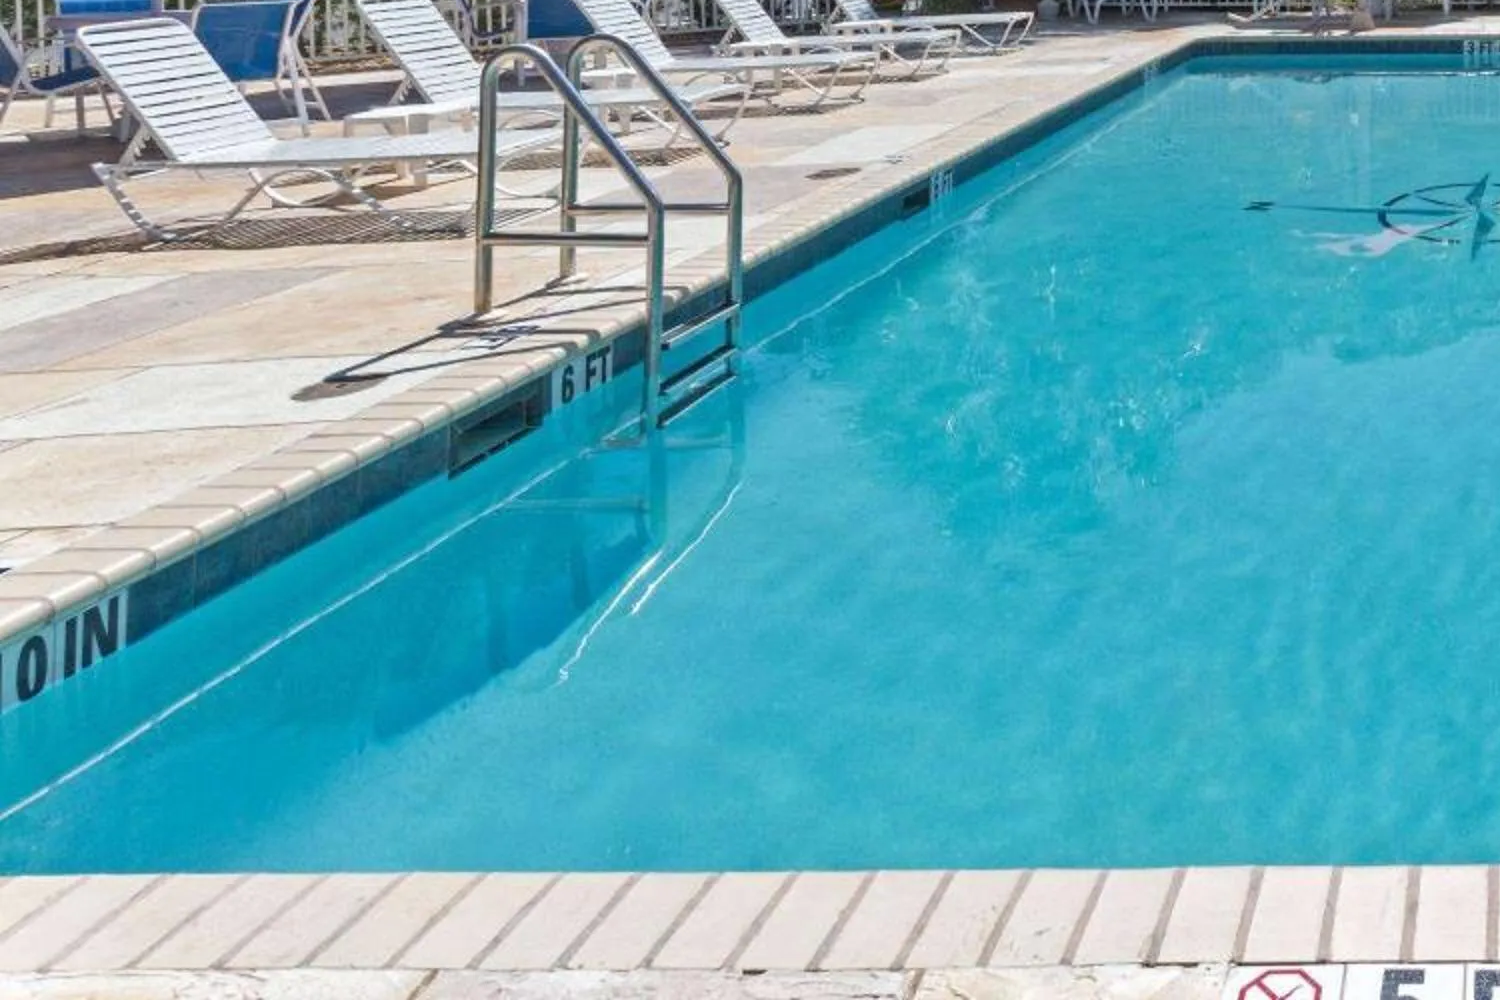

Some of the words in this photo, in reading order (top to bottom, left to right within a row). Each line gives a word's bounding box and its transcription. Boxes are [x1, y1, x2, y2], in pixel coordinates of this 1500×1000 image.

[561, 365, 574, 404] 6
[585, 346, 611, 392] FT
[0, 635, 48, 712] 0
[64, 596, 119, 680] IN
